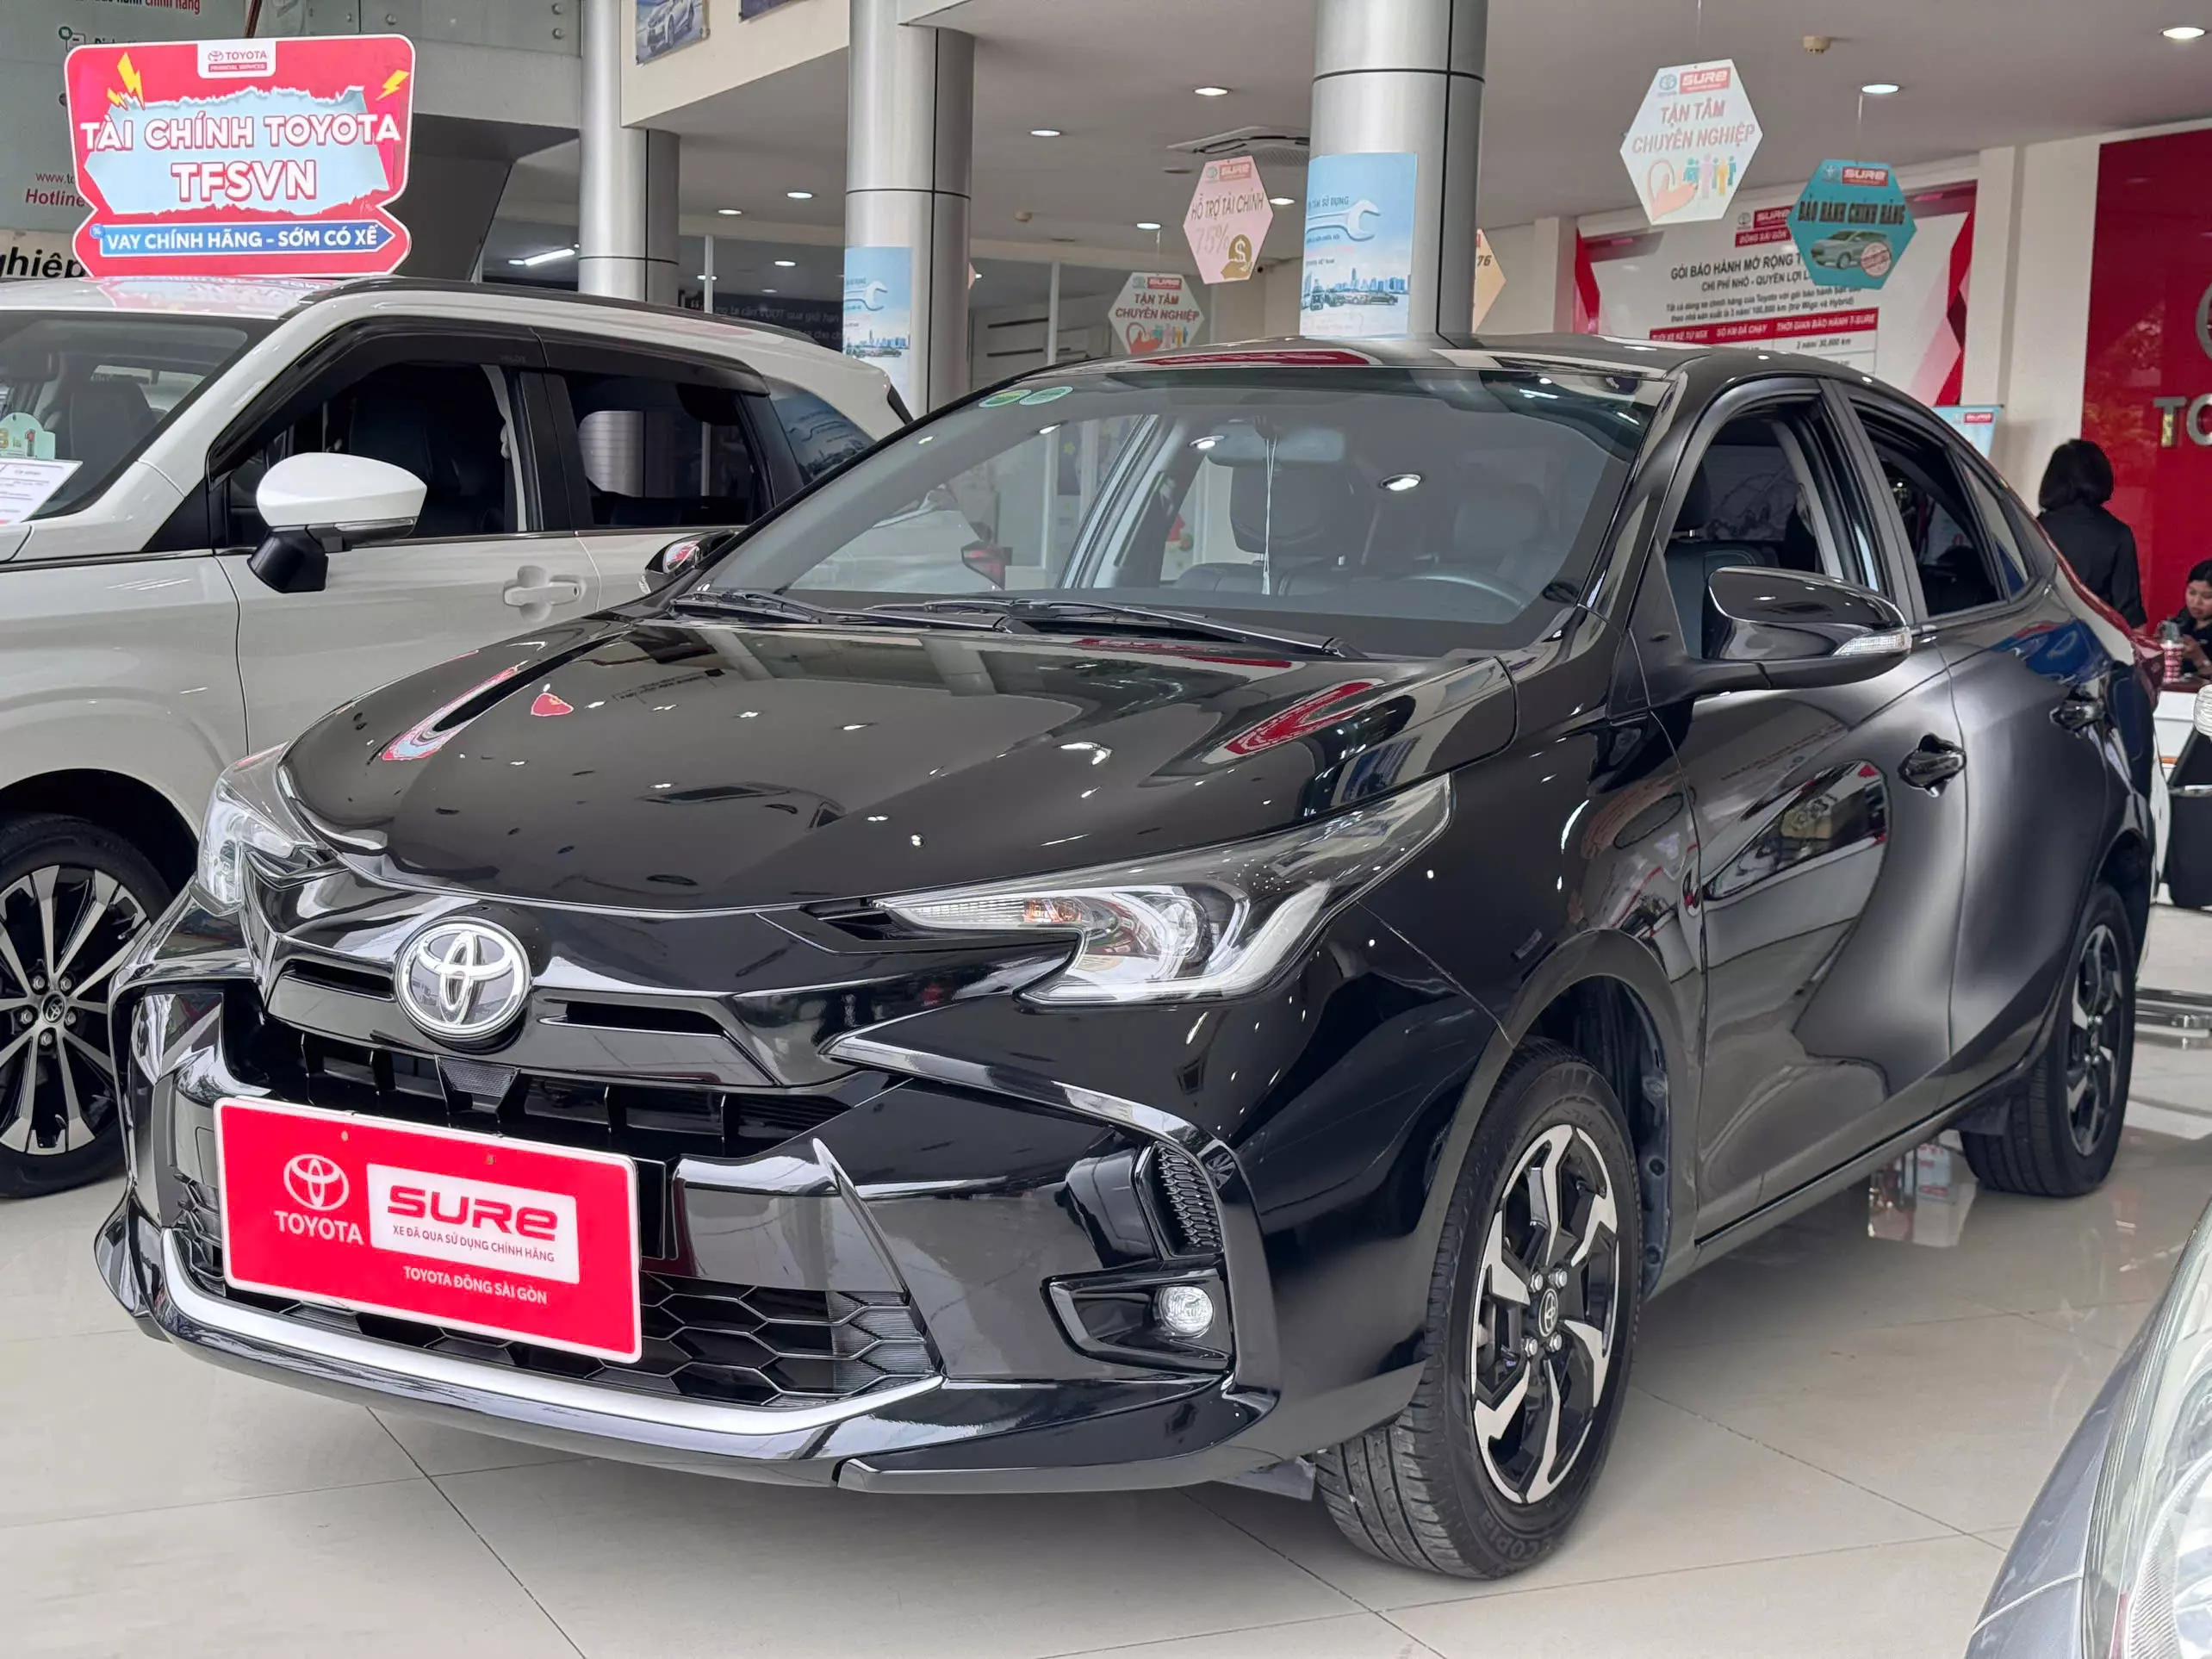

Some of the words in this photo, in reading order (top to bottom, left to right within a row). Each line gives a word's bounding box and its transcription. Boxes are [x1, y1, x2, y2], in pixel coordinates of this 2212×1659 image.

[225, 50, 267, 60] TOYOTA
[1661, 103, 1690, 127] TẬN
[1693, 96, 1726, 121] TÂM
[80, 115, 134, 152] TÀI
[144, 110, 254, 151] CHÍNH
[264, 114, 402, 146] TOYOTA
[1631, 127, 1693, 153] CHUYÊN
[1696, 121, 1755, 147] NGHIỆP
[171, 158, 317, 202] TFSVN
[25, 189, 86, 208] Hotline
[107, 233, 142, 250] VAY
[144, 228, 203, 249] CHÍNH
[208, 227, 263, 248] HÃNG
[277, 227, 320, 247] SỚM
[324, 226, 351, 246] CÓ
[1196, 223, 1230, 255] 75%
[1713, 258, 1741, 275] HÀNH
[1763, 254, 1793, 270] RỘNG
[1115, 307, 1158, 320] CHUYÊN
[1159, 309, 1200, 323] NGHIỆP
[1134, 293, 1156, 306] TẬN
[1158, 293, 1179, 305] TÂM
[274, 1210, 364, 1246] TOYOTA
[393, 1225, 405, 1236] XE
[407, 1226, 420, 1239] ĐÃ
[422, 1230, 443, 1243] QUA
[445, 1232, 458, 1245] SỬ
[460, 1236, 489, 1251] DỤNG
[491, 1240, 523, 1258] CHÍNH
[525, 1246, 556, 1263] HÃNG
[403, 1265, 453, 1287] TOYOTA
[454, 1273, 493, 1294] ĐÔNG
[494, 1281, 515, 1299] SÀI
[517, 1285, 548, 1305] GÒN
